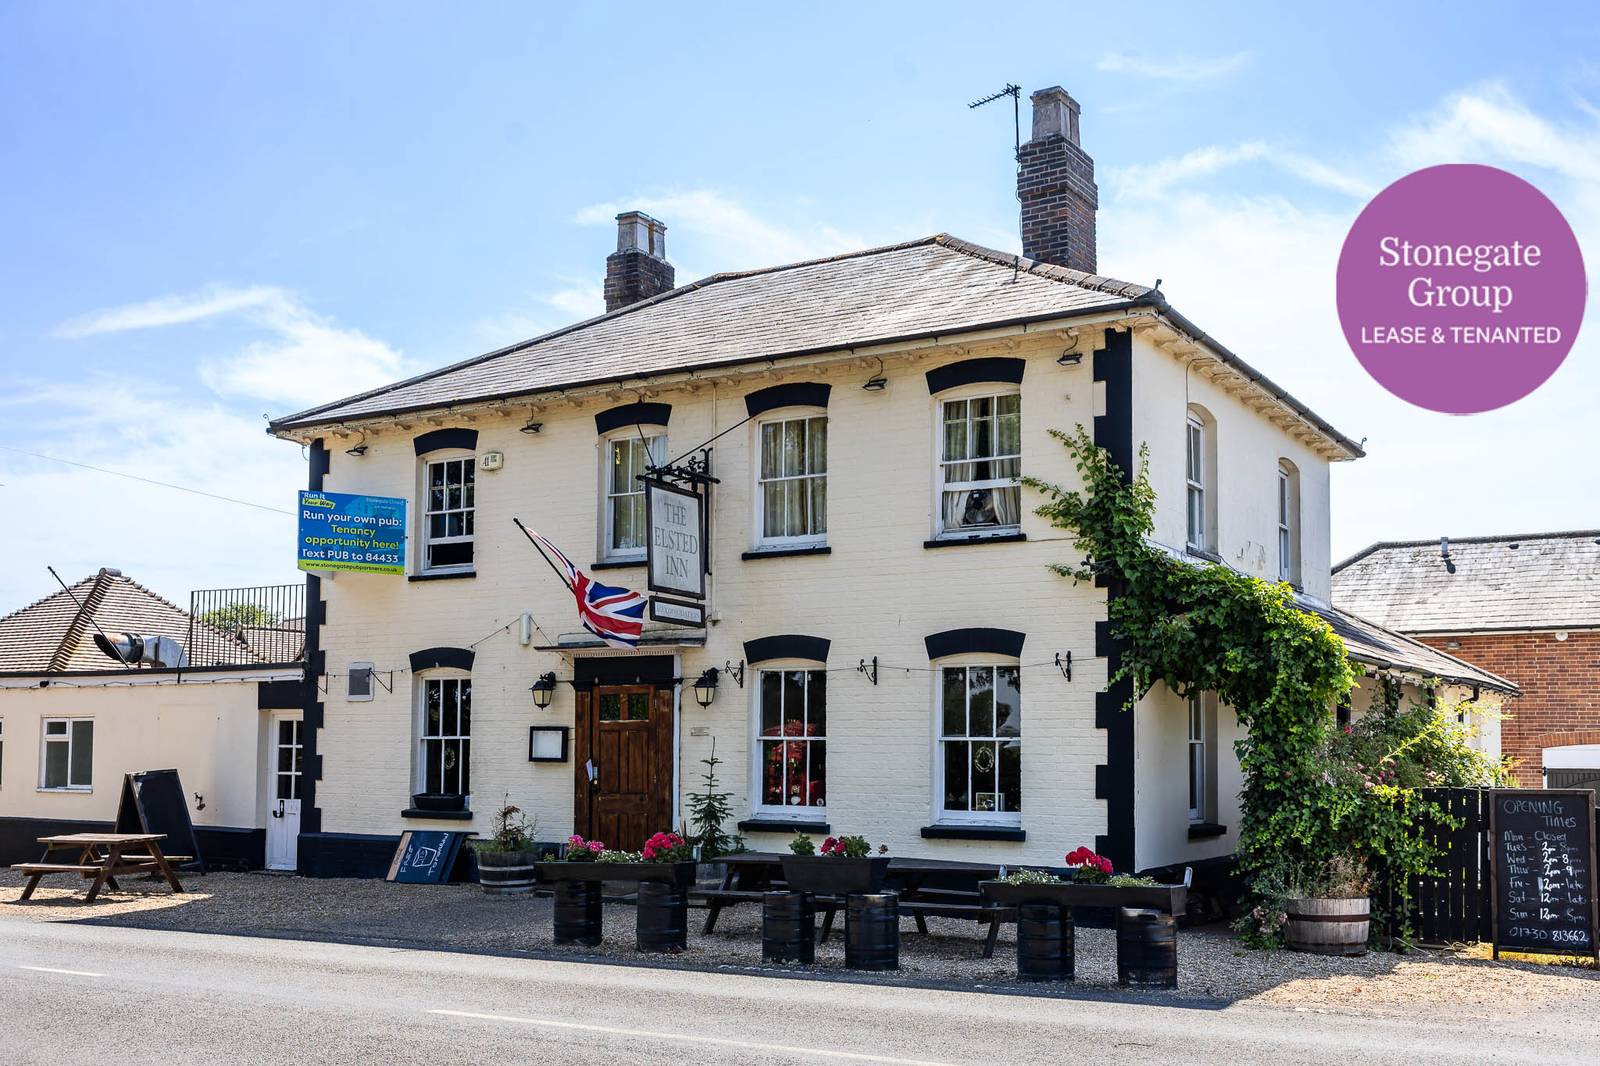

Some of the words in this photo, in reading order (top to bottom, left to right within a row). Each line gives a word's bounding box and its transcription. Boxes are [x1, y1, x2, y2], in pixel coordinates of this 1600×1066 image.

[303, 510, 325, 520] Run
[327, 514, 351, 523] your
[353, 516, 376, 524] own
[378, 517, 402, 527] pub:
[664, 502, 687, 526] THE
[331, 525, 375, 537] Tenancy
[305, 537, 370, 549] opportunity
[372, 540, 399, 550] here!
[654, 526, 698, 555] ELSTED
[302, 548, 325, 558] Text
[327, 550, 349, 559] PUB
[351, 552, 363, 561] to
[365, 553, 398, 563] 84433
[305, 562, 397, 573] www.stonegatepubpartners.co.uk
[665, 555, 688, 578] INN
[1503, 800, 1564, 815] OPENING
[1504, 830, 1524, 841] Mon
[1534, 831, 1567, 841] Closed
[1504, 842, 1528, 852] Tues
[1506, 852, 1526, 864] Wed
[1509, 876, 1523, 889] Fri
[1508, 891, 1526, 903] Sat
[1508, 908, 1528, 920] Sun
[1509, 926, 1548, 939] 01730
[1552, 930, 1589, 942] 813662
